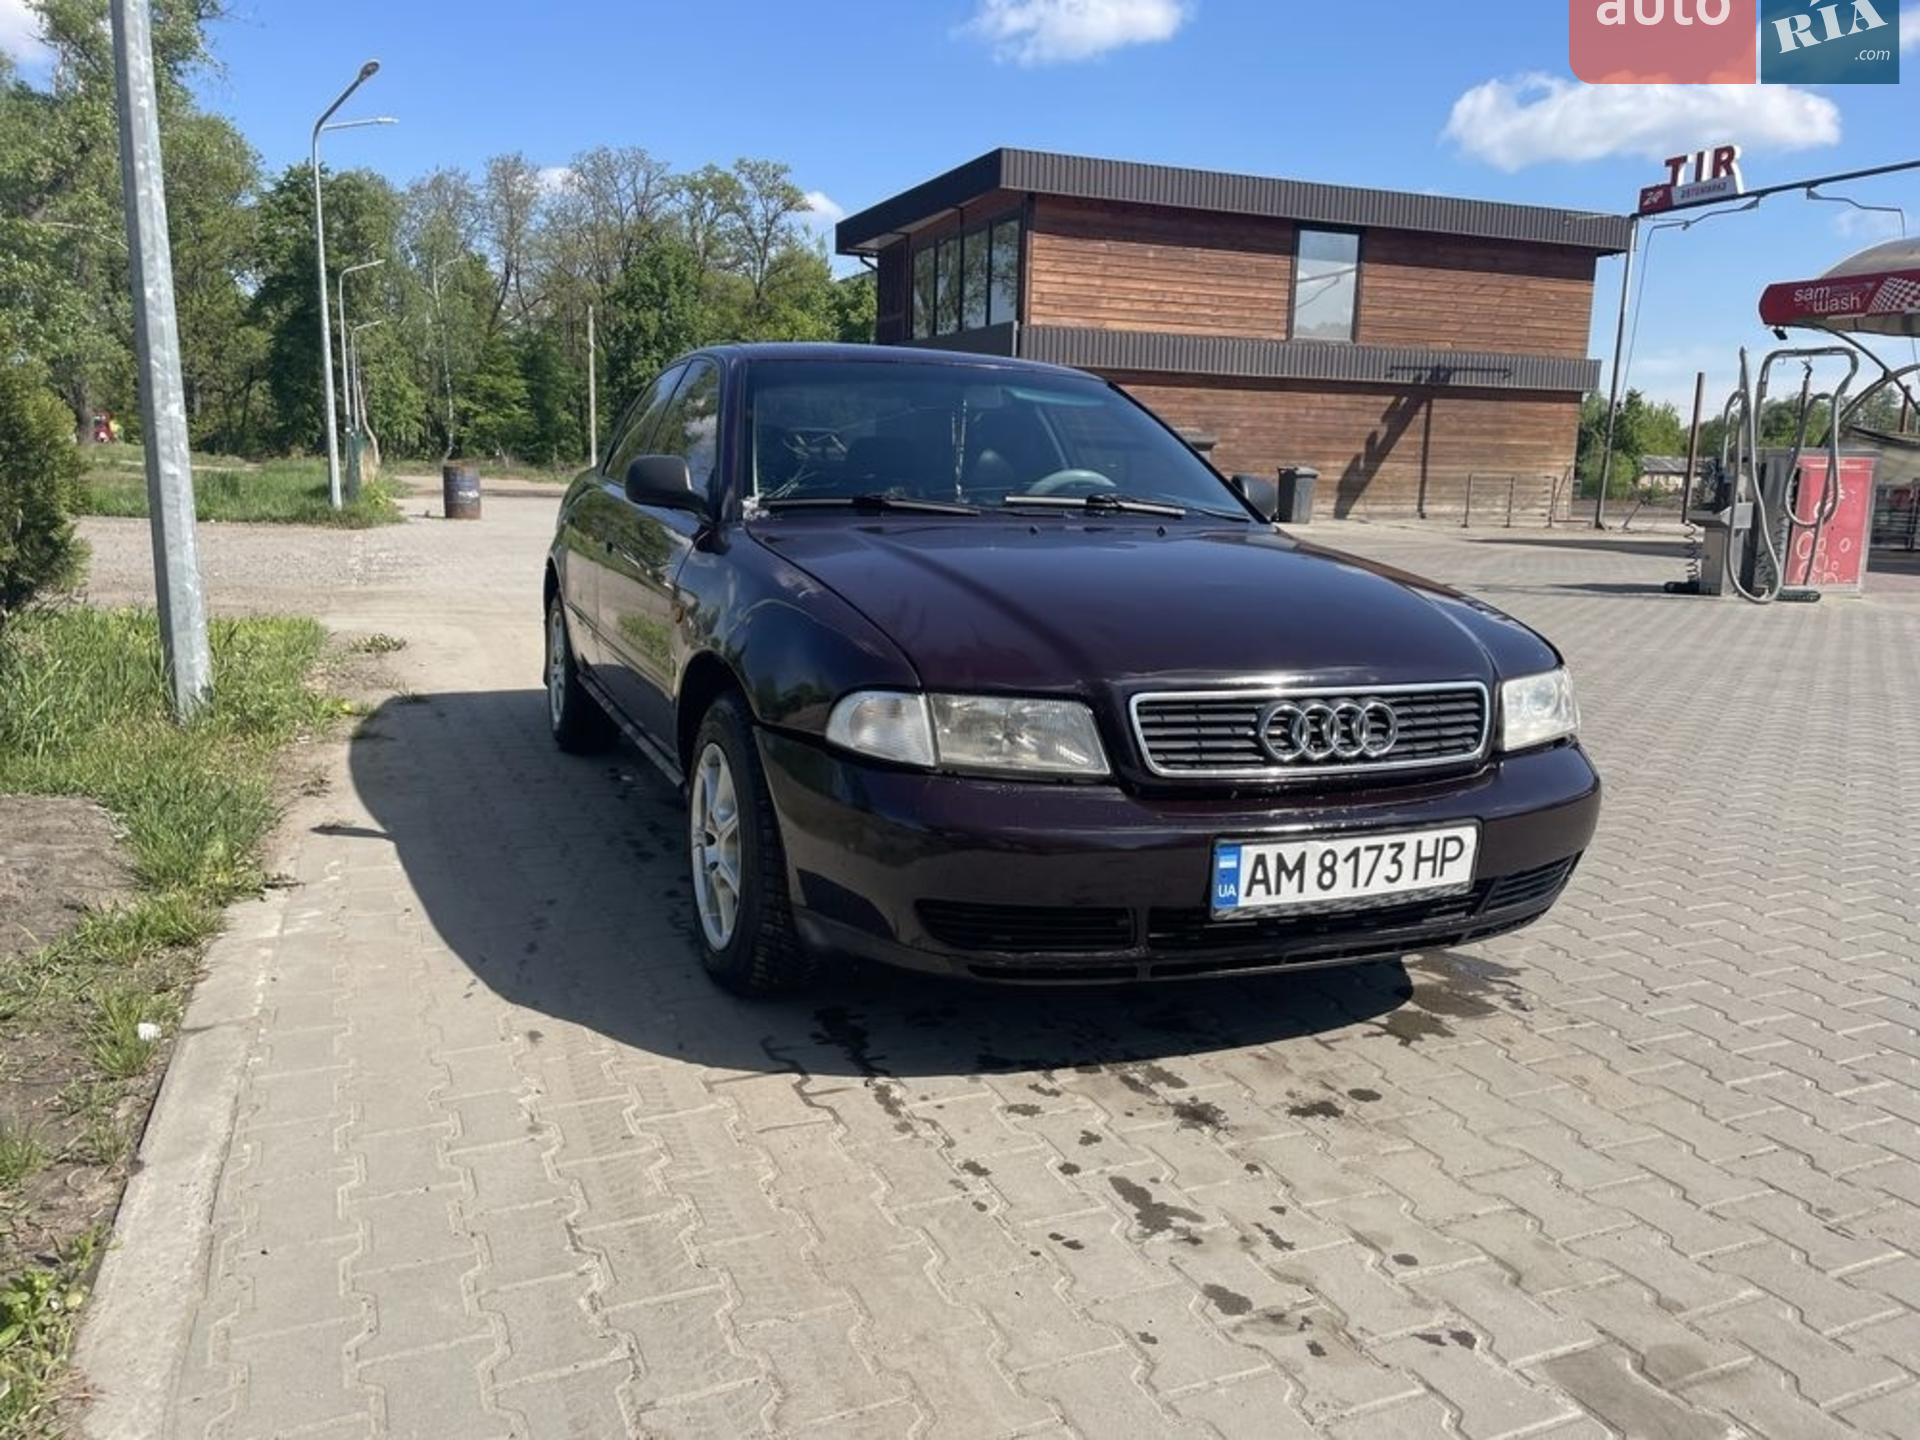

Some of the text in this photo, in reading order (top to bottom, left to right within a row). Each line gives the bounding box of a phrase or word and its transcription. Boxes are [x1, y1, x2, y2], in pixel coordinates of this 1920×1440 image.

[1665, 145, 1737, 187] TIR
[1794, 285, 1831, 303] sam
[1813, 294, 1862, 313] wash
[1245, 835, 1465, 898] AM 8173 HP
[1218, 884, 1237, 898] UA
